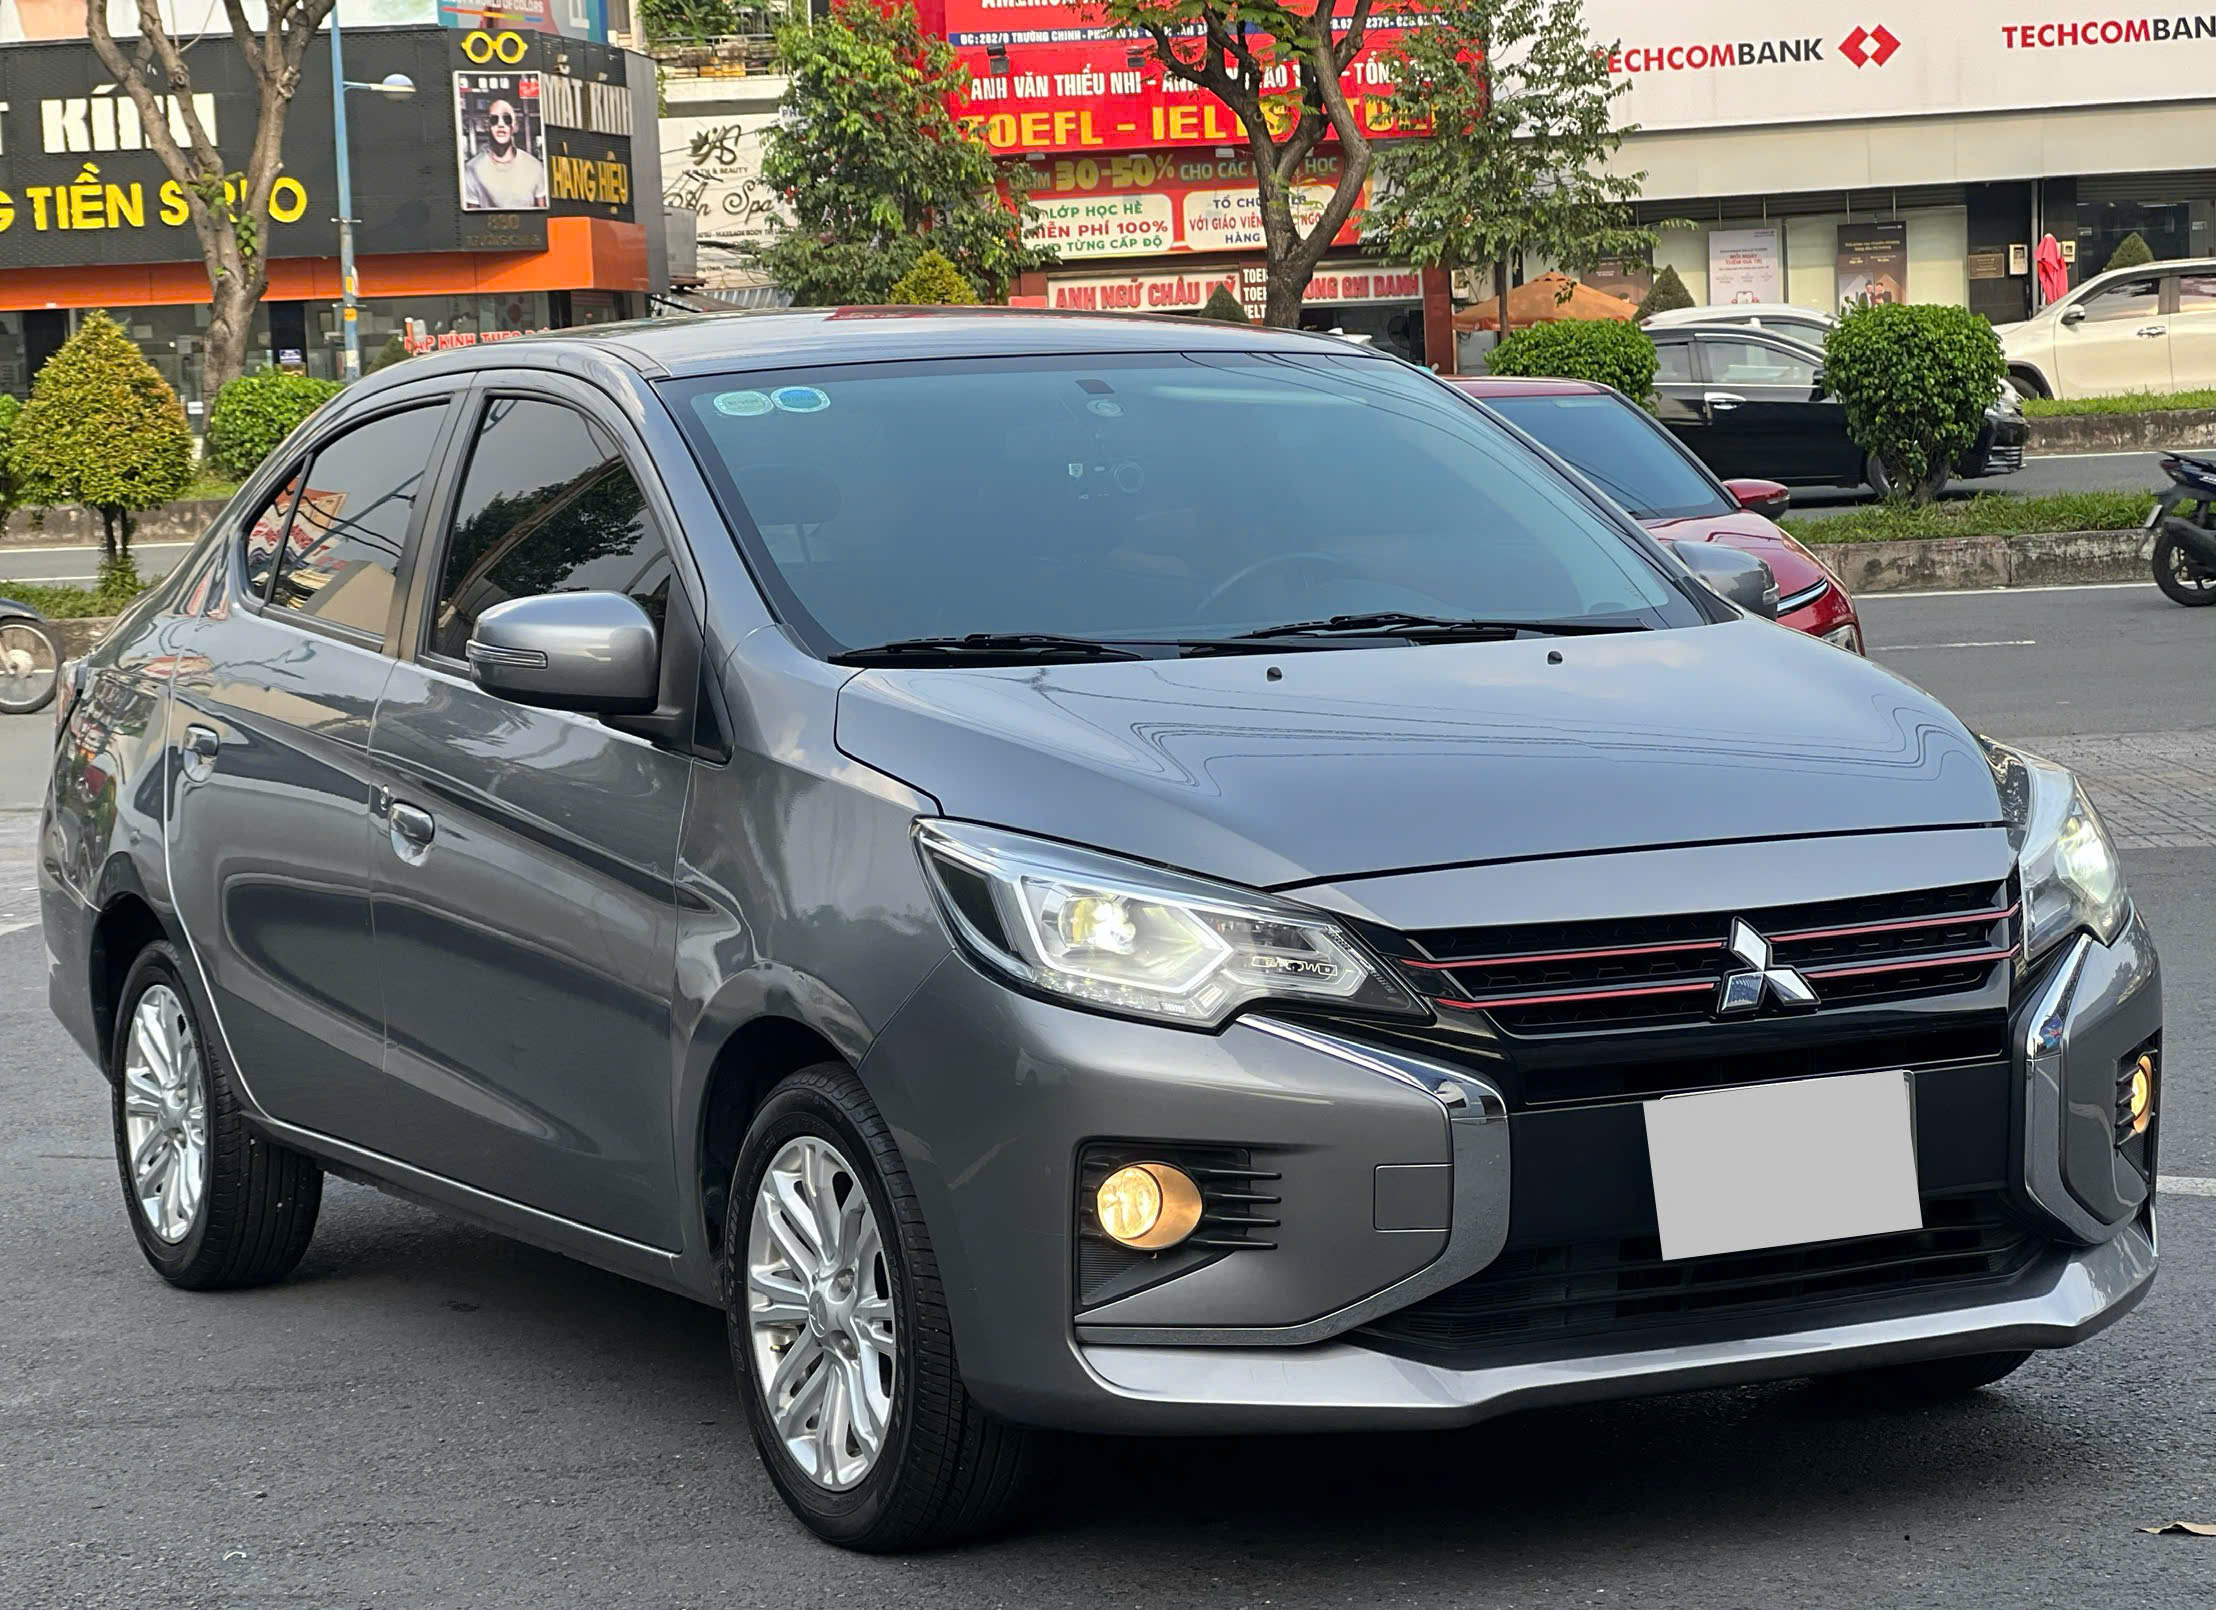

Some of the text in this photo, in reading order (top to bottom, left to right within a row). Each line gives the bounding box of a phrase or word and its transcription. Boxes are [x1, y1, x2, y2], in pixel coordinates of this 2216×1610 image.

[1051, 29, 1081, 42] CHINH
[2001, 15, 2216, 49] TECHCOMBAN
[1595, 38, 1823, 73] ECHCOMBANK
[971, 78, 1008, 100] ANH
[1014, 71, 1048, 98] VĂN
[1053, 63, 1105, 97] THIẾU
[1110, 72, 1141, 95] NHI
[960, 110, 1103, 149] TOEFL
[551, 142, 597, 203] HÀNG
[598, 150, 629, 215] HIỆU
[1055, 153, 1175, 192] 30-50%
[1180, 163, 1213, 180] CHO
[1217, 156, 1247, 178] CÁC
[1305, 156, 1338, 177] HỌC
[26, 162, 145, 230] TIỀN
[1050, 200, 1143, 219] LỚP HỌC HÈ
[1213, 194, 1231, 209] TỔ
[1078, 219, 1110, 236] PHÍ
[1116, 220, 1168, 235] 100%
[1189, 216, 1207, 231] VỚI
[1212, 216, 1236, 231] GIÁO
[1241, 213, 1264, 228] VIÊN
[1068, 239, 1105, 252] TỪNG
[1110, 235, 1138, 249] CẤP
[1143, 234, 1163, 249] ĐỘ
[1225, 231, 1261, 244] HÀNG
[1056, 286, 1096, 309] ANH
[1101, 277, 1143, 309] NGỮ
[1148, 275, 1199, 306] CHÂU
[1342, 276, 1369, 298] GHI
[1373, 274, 1418, 298] DANH
